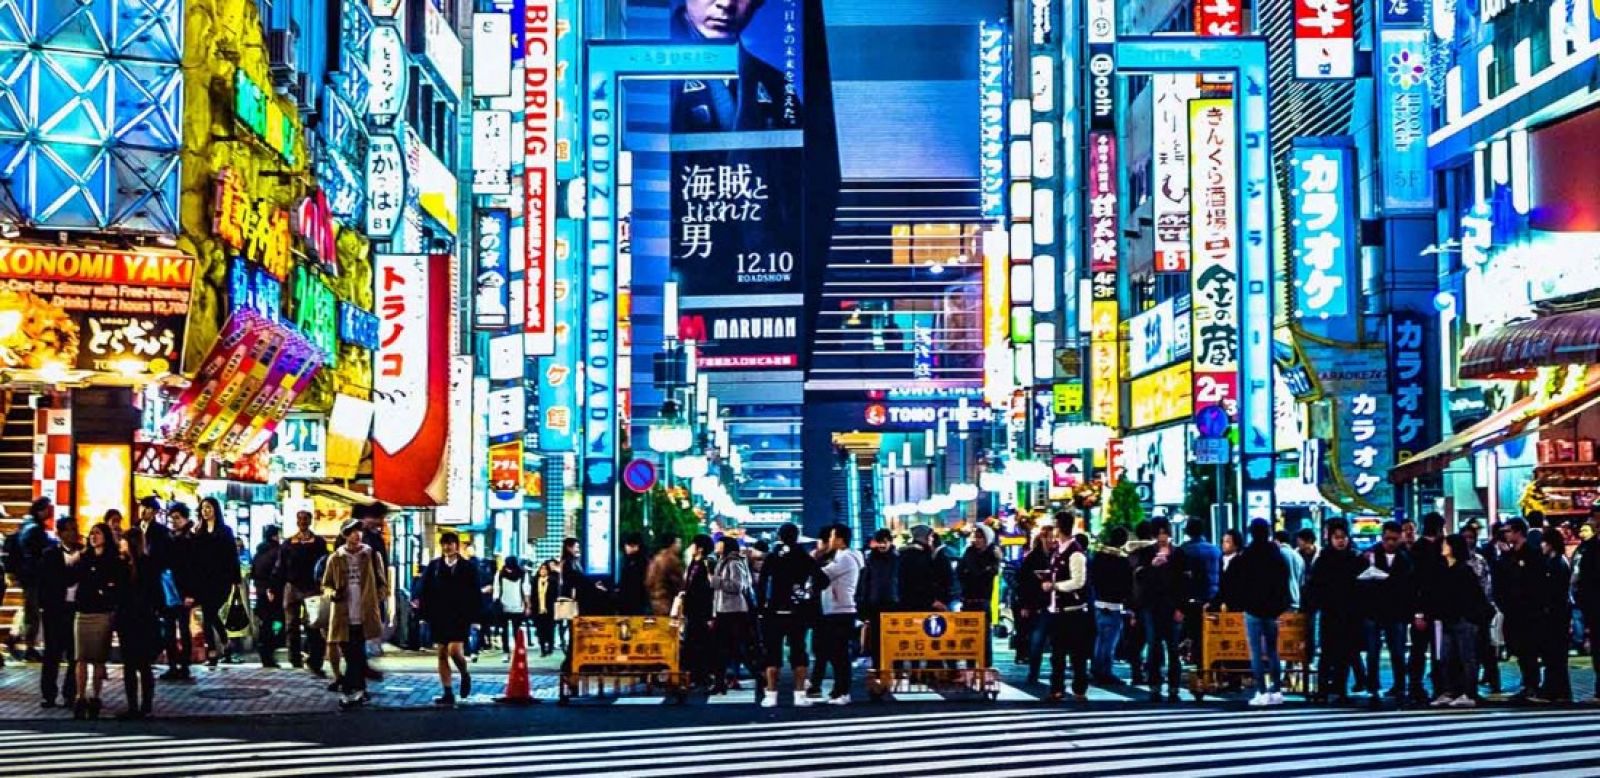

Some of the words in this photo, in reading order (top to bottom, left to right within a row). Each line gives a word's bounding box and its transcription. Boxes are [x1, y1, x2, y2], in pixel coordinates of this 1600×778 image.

[526, 5, 547, 56] BIC
[784, 0, 797, 125] 、日本の未来を変えた。
[526, 68, 547, 155] DRUG
[592, 108, 611, 305] GODZILLA
[681, 164, 768, 201] 海賊と
[681, 201, 762, 222] よばれた
[1205, 107, 1227, 229] きんくら酒場
[124, 255, 192, 283] YAKI
[680, 223, 713, 258] 男
[736, 252, 793, 273] 12.10
[1302, 154, 1342, 309] カラオケ
[381, 266, 406, 378] トラノコ
[737, 274, 791, 283] ROADSHOW
[1196, 264, 1237, 367] 金の蔵
[714, 316, 797, 339] MARUHAN
[592, 329, 611, 422] ROAD
[1197, 376, 1228, 402] 2F
[1397, 320, 1424, 444] カラオケ
[1351, 394, 1380, 496] カラオケ
